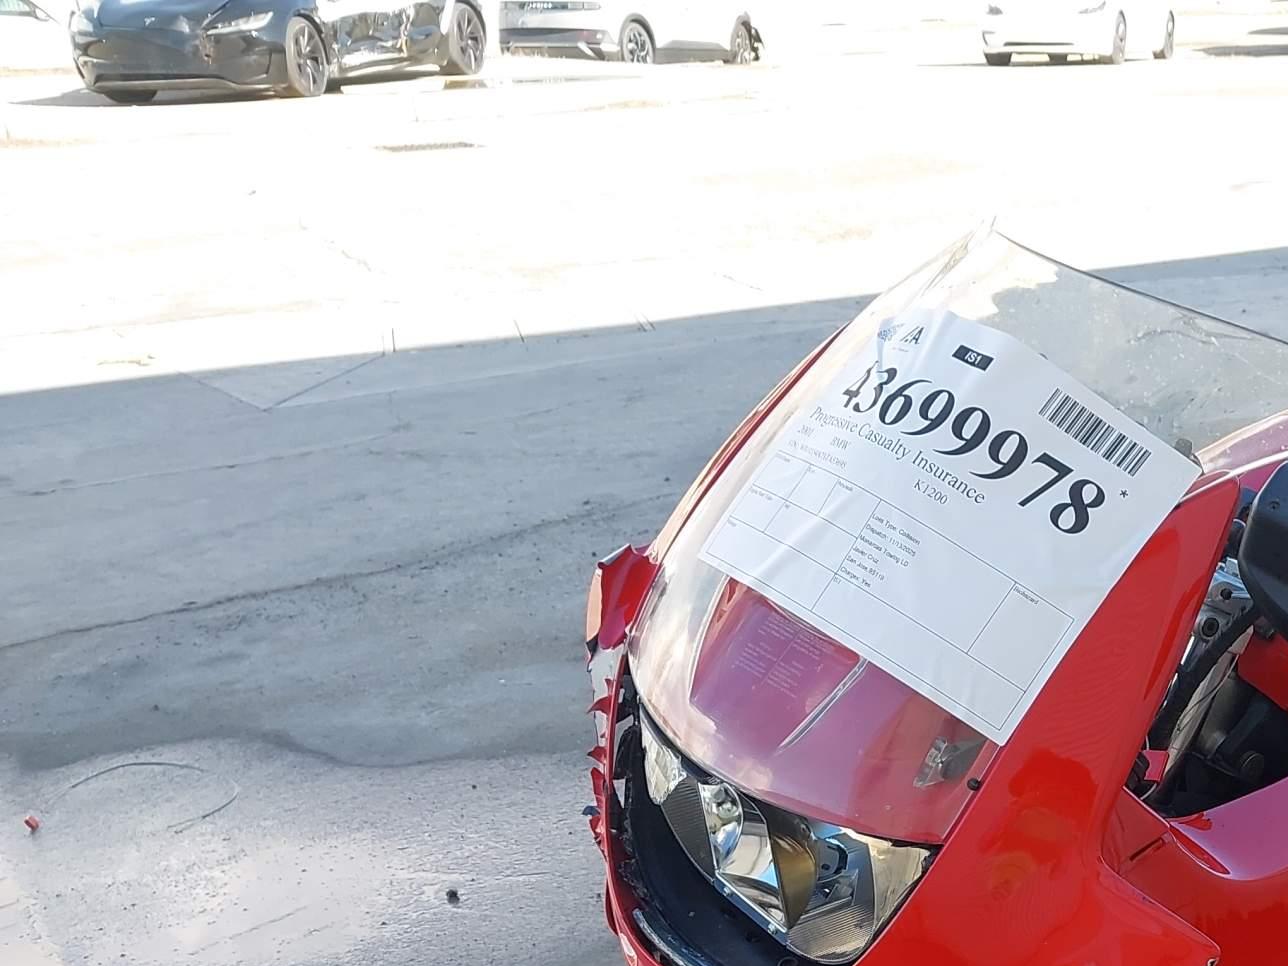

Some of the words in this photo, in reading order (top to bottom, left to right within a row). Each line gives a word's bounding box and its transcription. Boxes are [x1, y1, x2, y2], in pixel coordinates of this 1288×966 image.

[964, 350, 983, 365] IS1
[810, 406, 858, 433] Progressive
[858, 422, 911, 461] Casualty
[912, 450, 985, 504] Insurance
[842, 360, 1106, 535] 43699978
[914, 478, 948, 505] K1200
